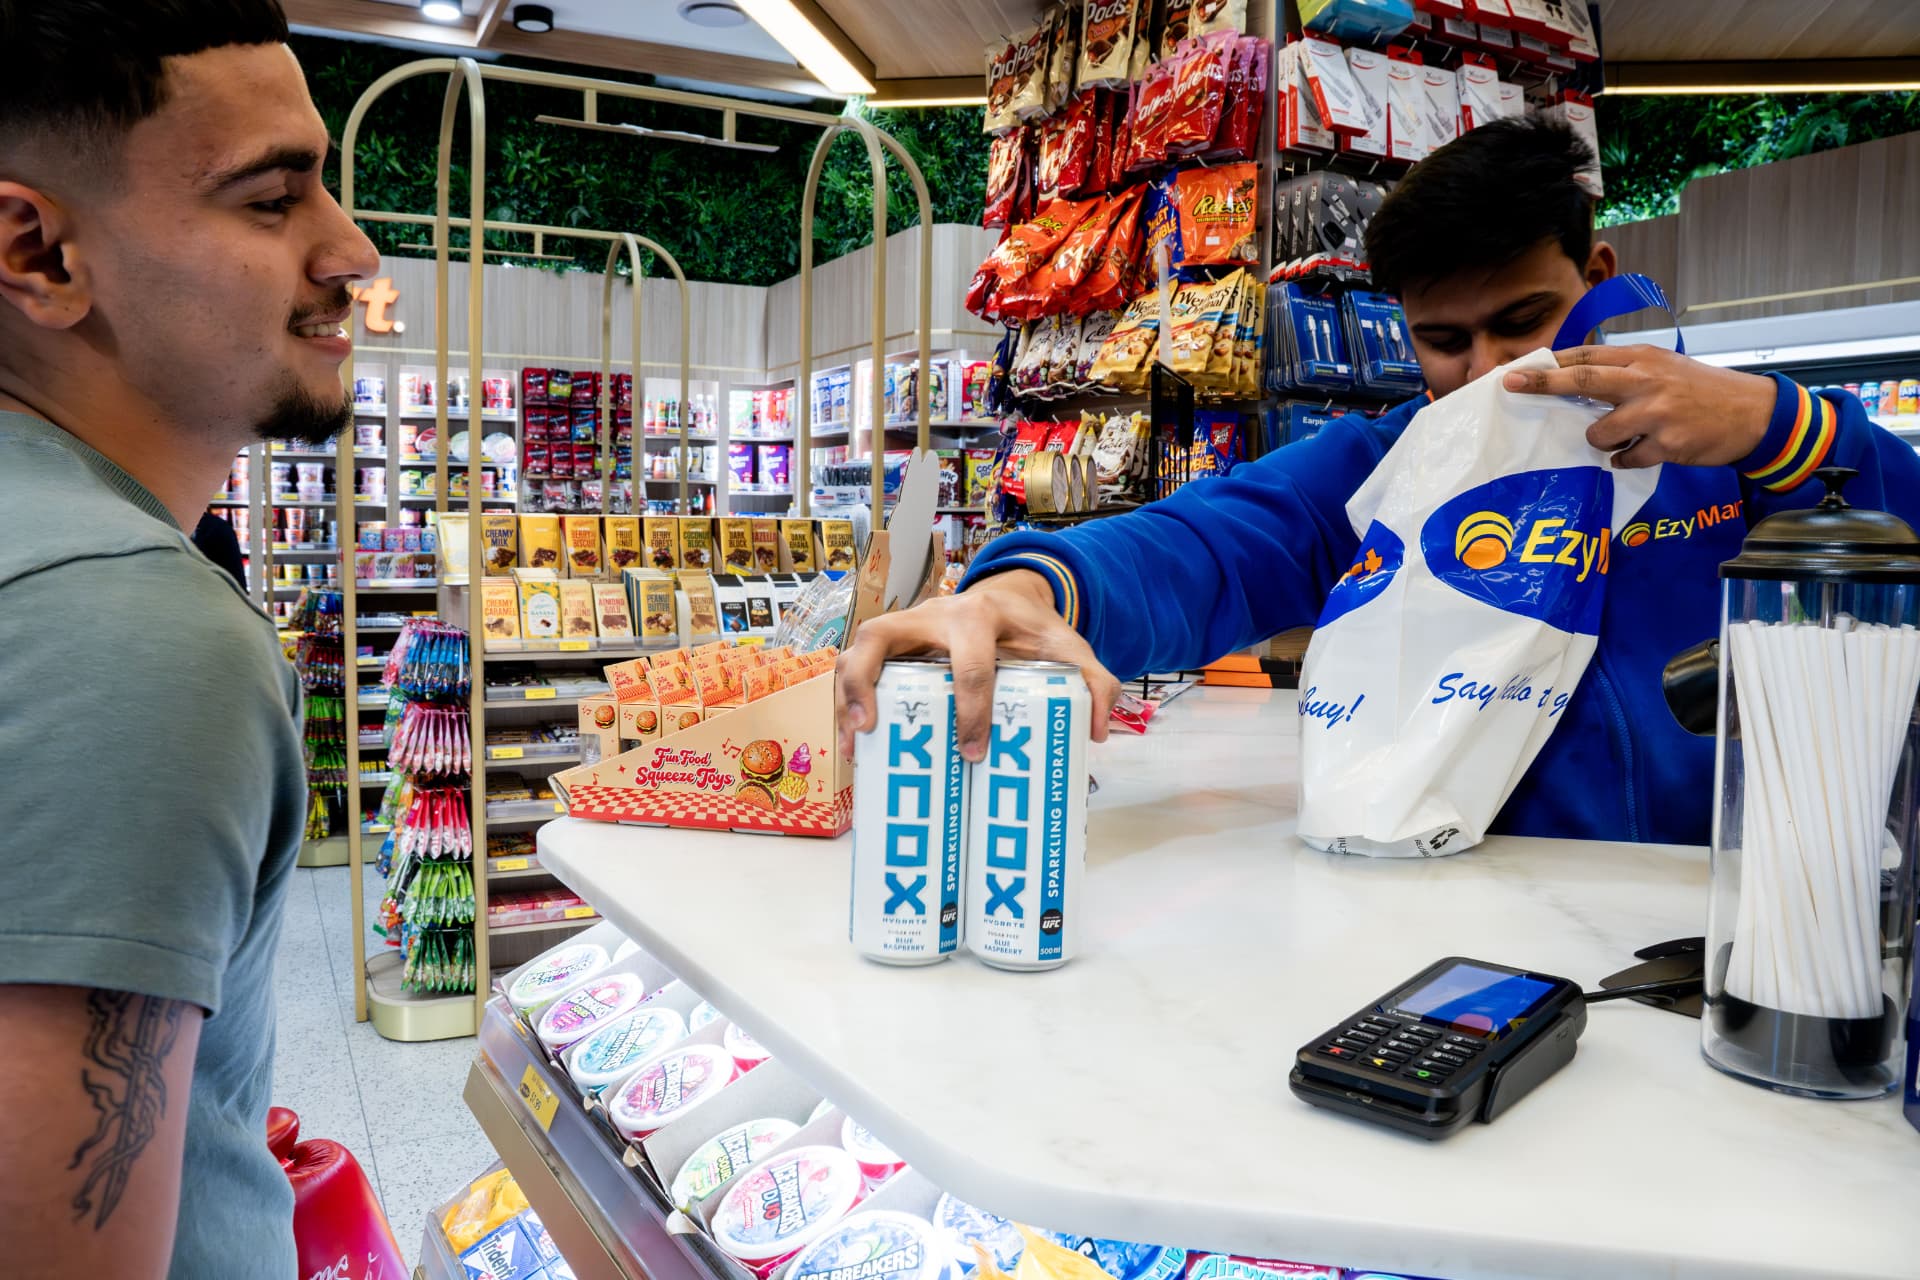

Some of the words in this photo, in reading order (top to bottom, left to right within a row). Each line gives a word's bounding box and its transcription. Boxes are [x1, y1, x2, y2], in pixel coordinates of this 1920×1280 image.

[1653, 499, 1744, 541] EzyMar
[485, 529, 514, 538] CREAMY
[491, 538, 508, 547] MILK
[484, 607, 517, 617] CARAMEL
[485, 599, 513, 608] CREAMY
[1431, 672, 1498, 712] Say
[651, 746, 679, 770] Fun
[678, 747, 711, 767] Food
[1051, 704, 1067, 802] HYDRATION
[635, 766, 695, 791] Squeeze
[695, 767, 735, 792] Toys
[946, 803, 959, 893] SPARKLING
[1047, 806, 1063, 898] SPARKLING
[882, 917, 927, 925] HYDRATE
[942, 913, 957, 923] UFC
[1042, 920, 1061, 929] UFC
[481, 1234, 518, 1280] Trident
[830, 1244, 920, 1280] BREAKERS
